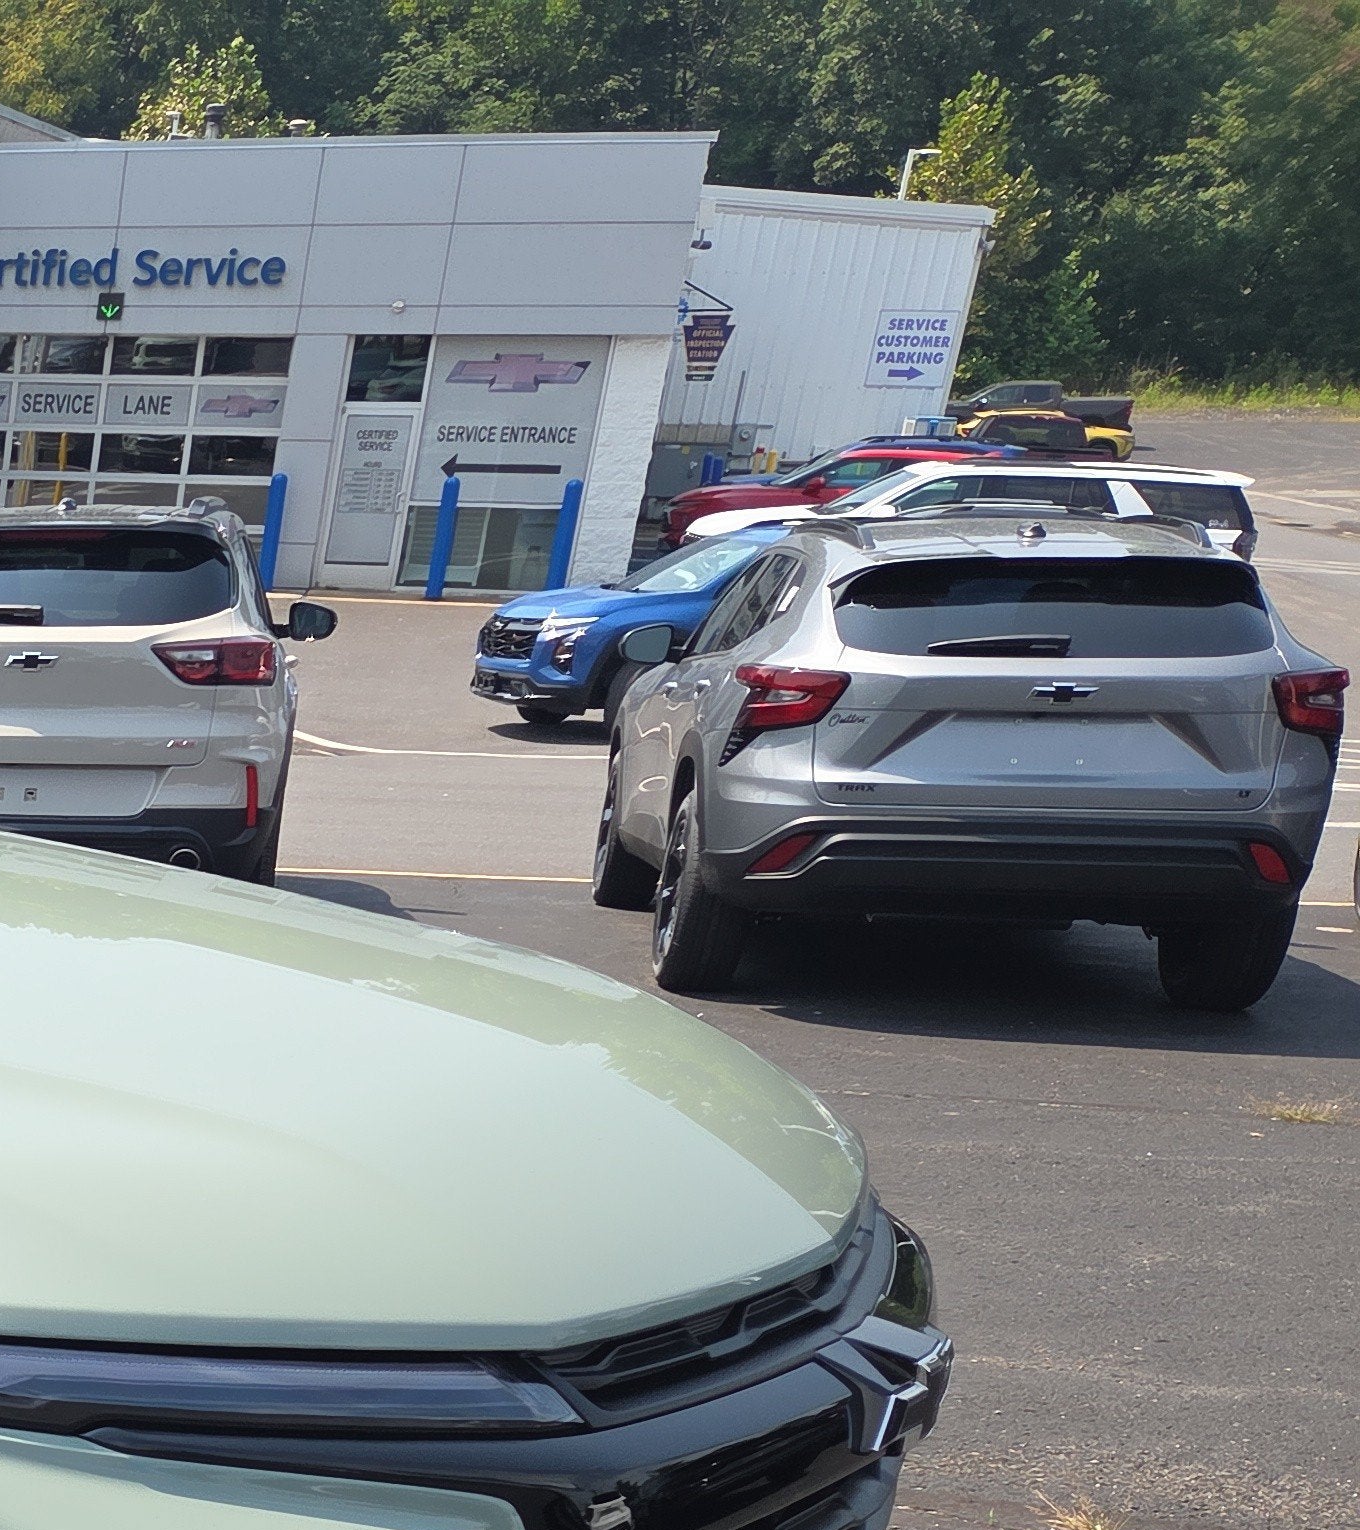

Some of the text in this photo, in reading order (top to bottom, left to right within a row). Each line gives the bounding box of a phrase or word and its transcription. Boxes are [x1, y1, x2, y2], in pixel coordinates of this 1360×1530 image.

[132, 247, 287, 287] Service
[888, 318, 948, 331] SERVICE
[692, 329, 724, 338] OFFICIAL
[877, 335, 950, 348] CUSTOMER
[875, 351, 944, 364] PARKING
[21, 393, 173, 416] SERVICE LANE
[356, 429, 398, 441] CERTIFIED
[437, 424, 578, 444] SERVICE ENTRANCE
[357, 441, 394, 452] SERVICE
[837, 784, 876, 792] TRAX
